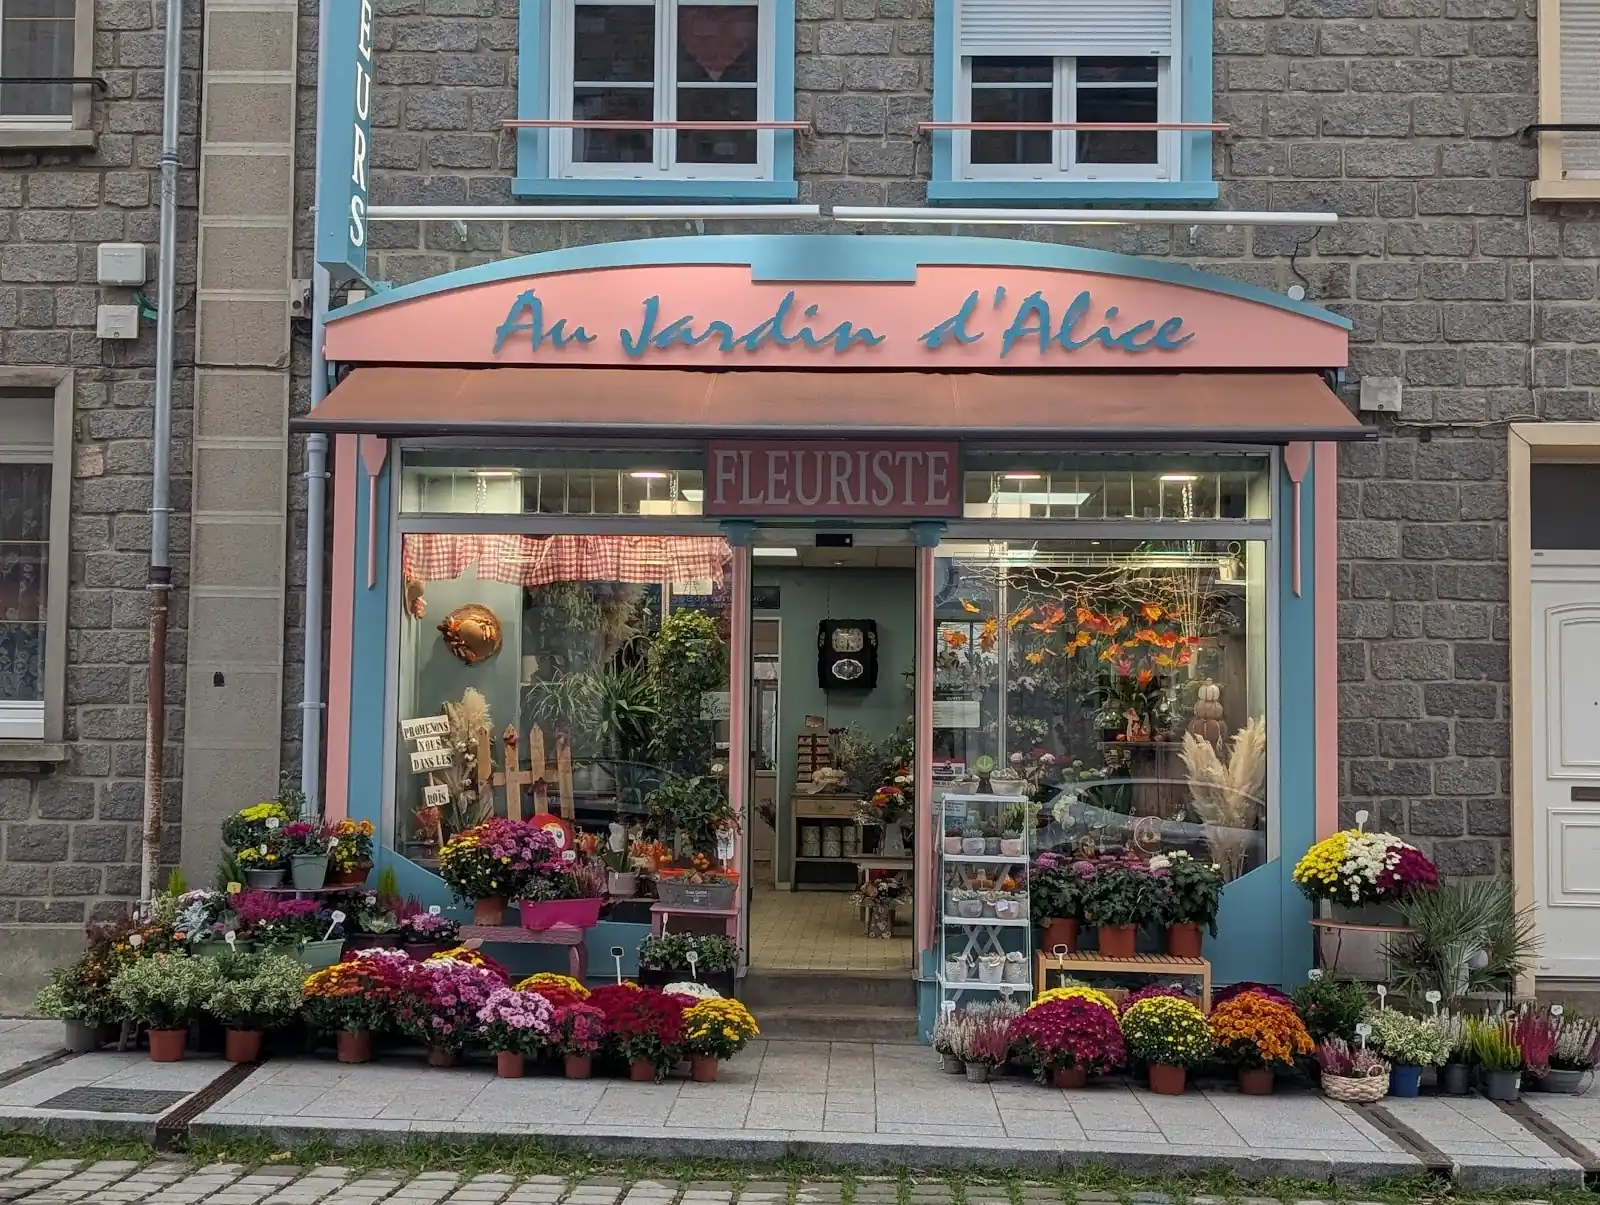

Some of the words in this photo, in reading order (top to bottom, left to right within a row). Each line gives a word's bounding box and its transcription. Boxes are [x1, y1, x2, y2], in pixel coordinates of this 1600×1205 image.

[492, 288, 597, 355] Au
[619, 290, 887, 357] Jardin
[917, 286, 1196, 358] d'Alice
[713, 449, 950, 506] FLEURISTE
[413, 757, 435, 770] DANS
[436, 753, 452, 766] LES
[418, 739, 442, 751] NOUS
